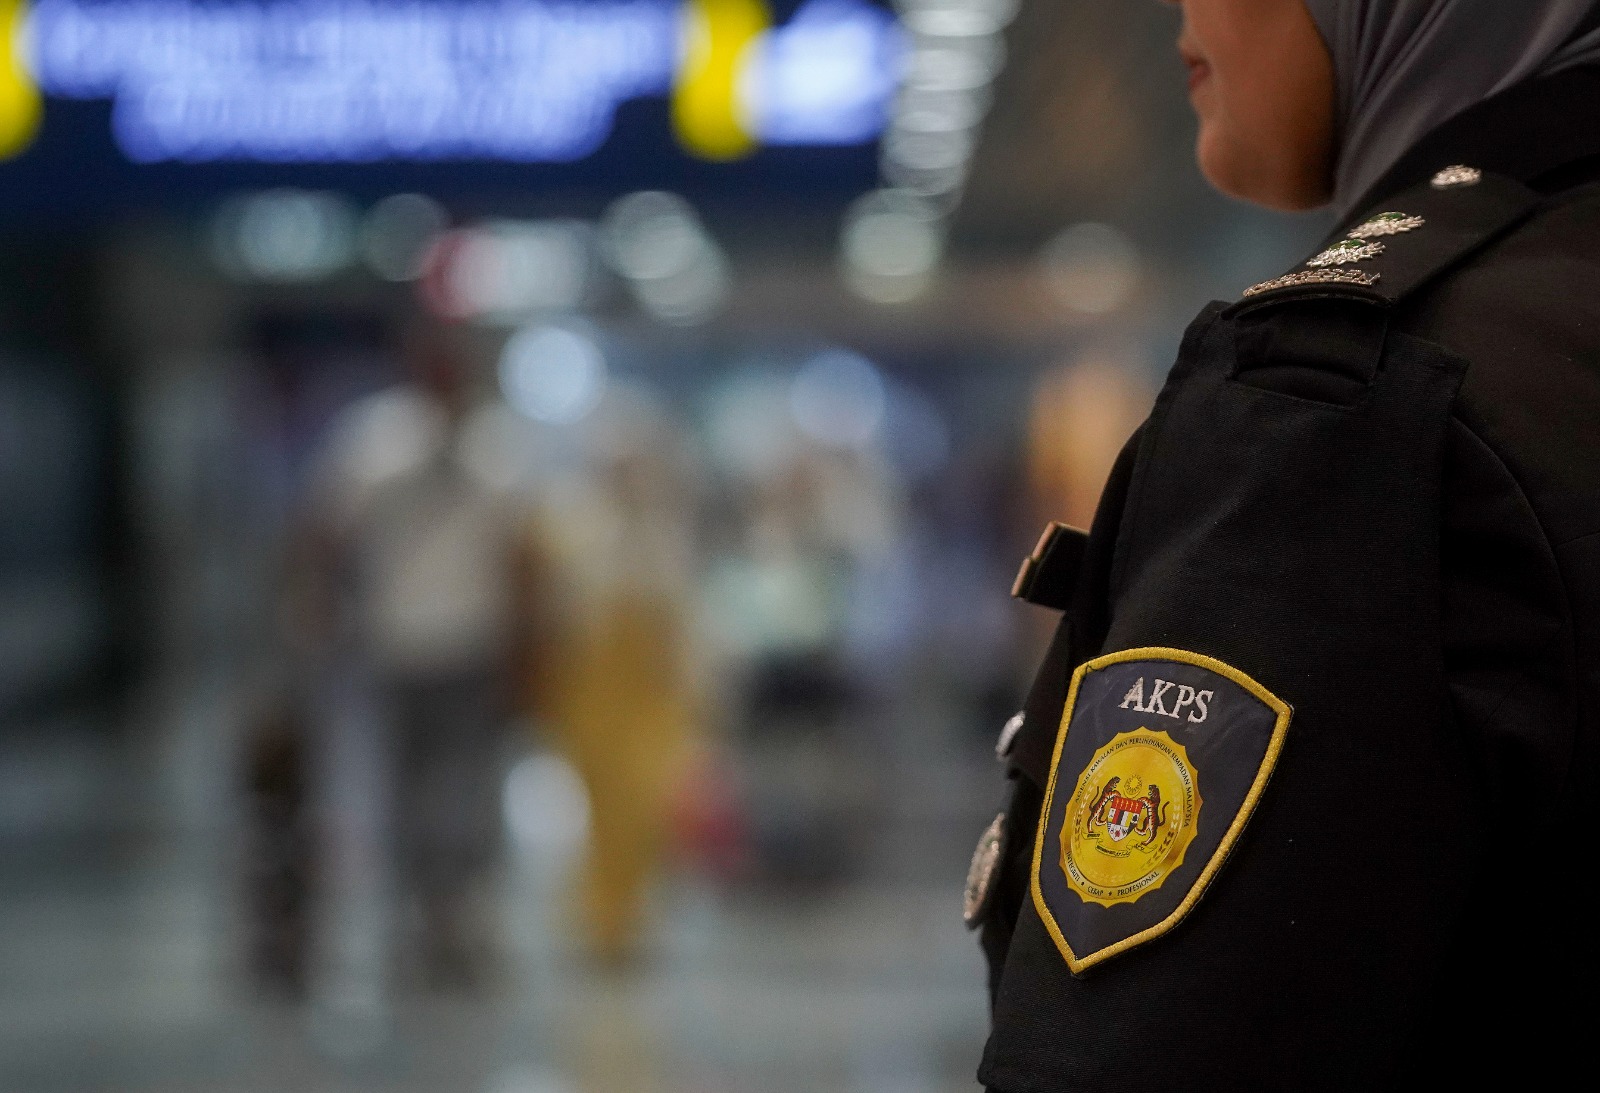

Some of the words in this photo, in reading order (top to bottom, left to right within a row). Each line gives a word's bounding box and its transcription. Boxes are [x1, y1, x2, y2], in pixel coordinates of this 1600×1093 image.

[1118, 677, 1214, 723] AKPS
[1075, 773, 1091, 802] AGENSI
[1090, 747, 1115, 773] KAWALAN
[1115, 741, 1128, 750] DAN
[1170, 753, 1190, 785] SEMPADAN
[1184, 786, 1193, 827] MALAYSIA
[1066, 850, 1080, 882] INTEGRITI
[1087, 886, 1104, 896] CEKAP
[1117, 871, 1160, 896] PROFESIONAL
